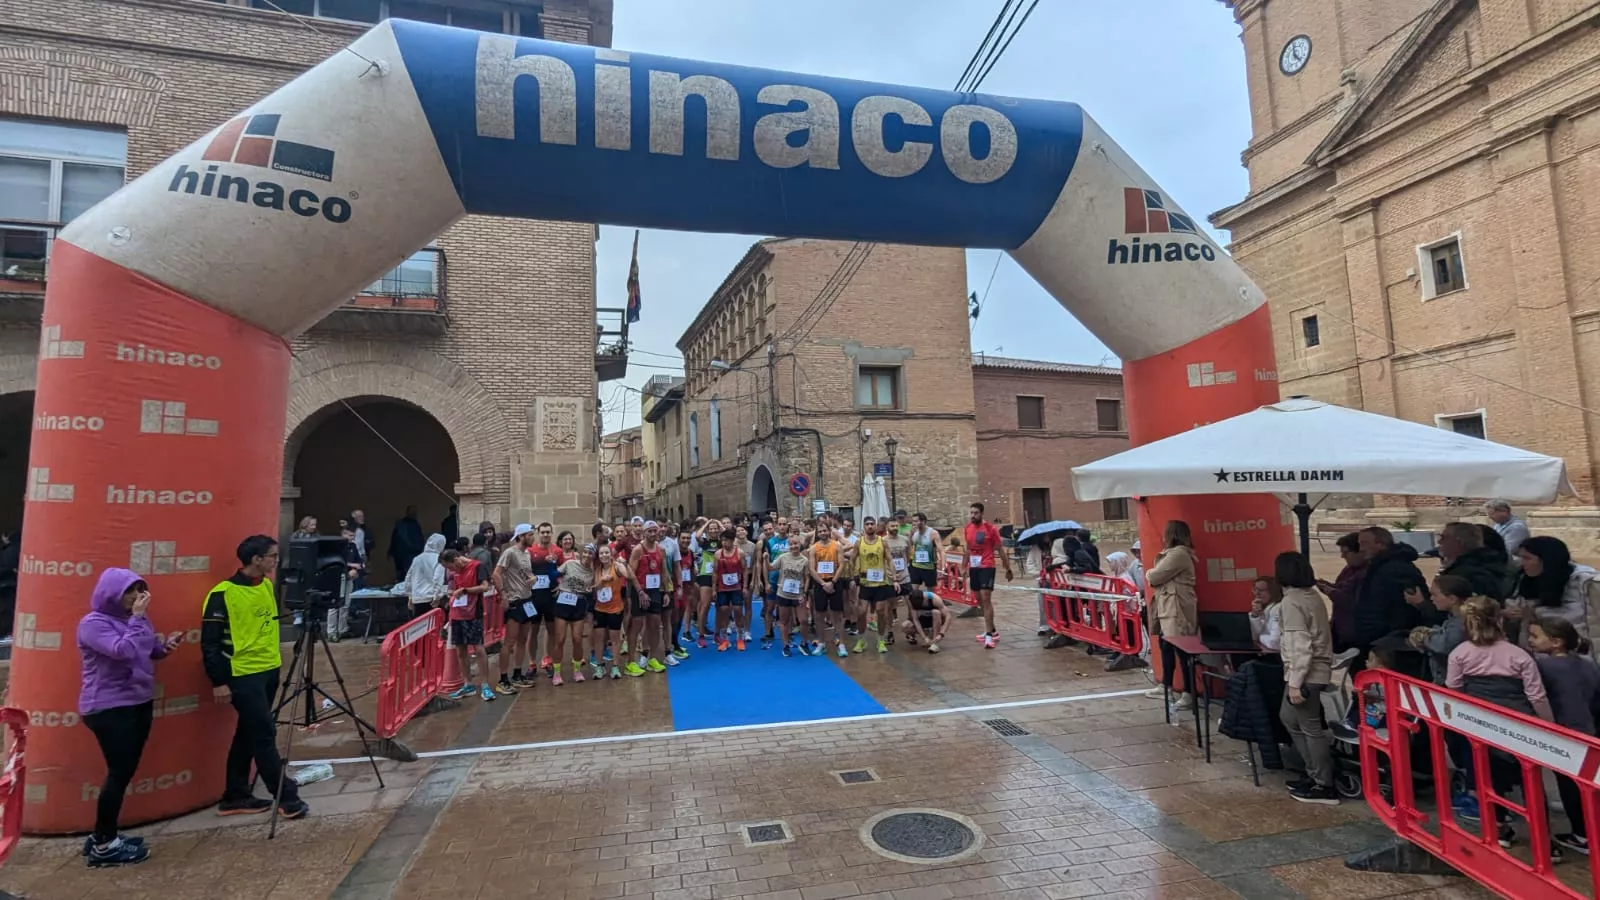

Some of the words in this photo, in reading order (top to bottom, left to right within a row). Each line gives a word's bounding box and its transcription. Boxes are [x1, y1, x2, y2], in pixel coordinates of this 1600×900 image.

[475, 34, 1018, 184] hinaco
[273, 162, 330, 180] Constructora
[1108, 237, 1216, 264] hinaco
[115, 343, 222, 370] hinaco
[1233, 471, 1296, 482] ESTRELLA
[1300, 470, 1344, 481] DAMM
[106, 485, 213, 504] hinaco
[1203, 518, 1267, 533] hinaco
[1457, 712, 1498, 732] AYUNTAMIENTO
[1499, 727, 1508, 736] DE
[1509, 730, 1538, 747] ALCOLEA
[81, 769, 192, 801] haco
